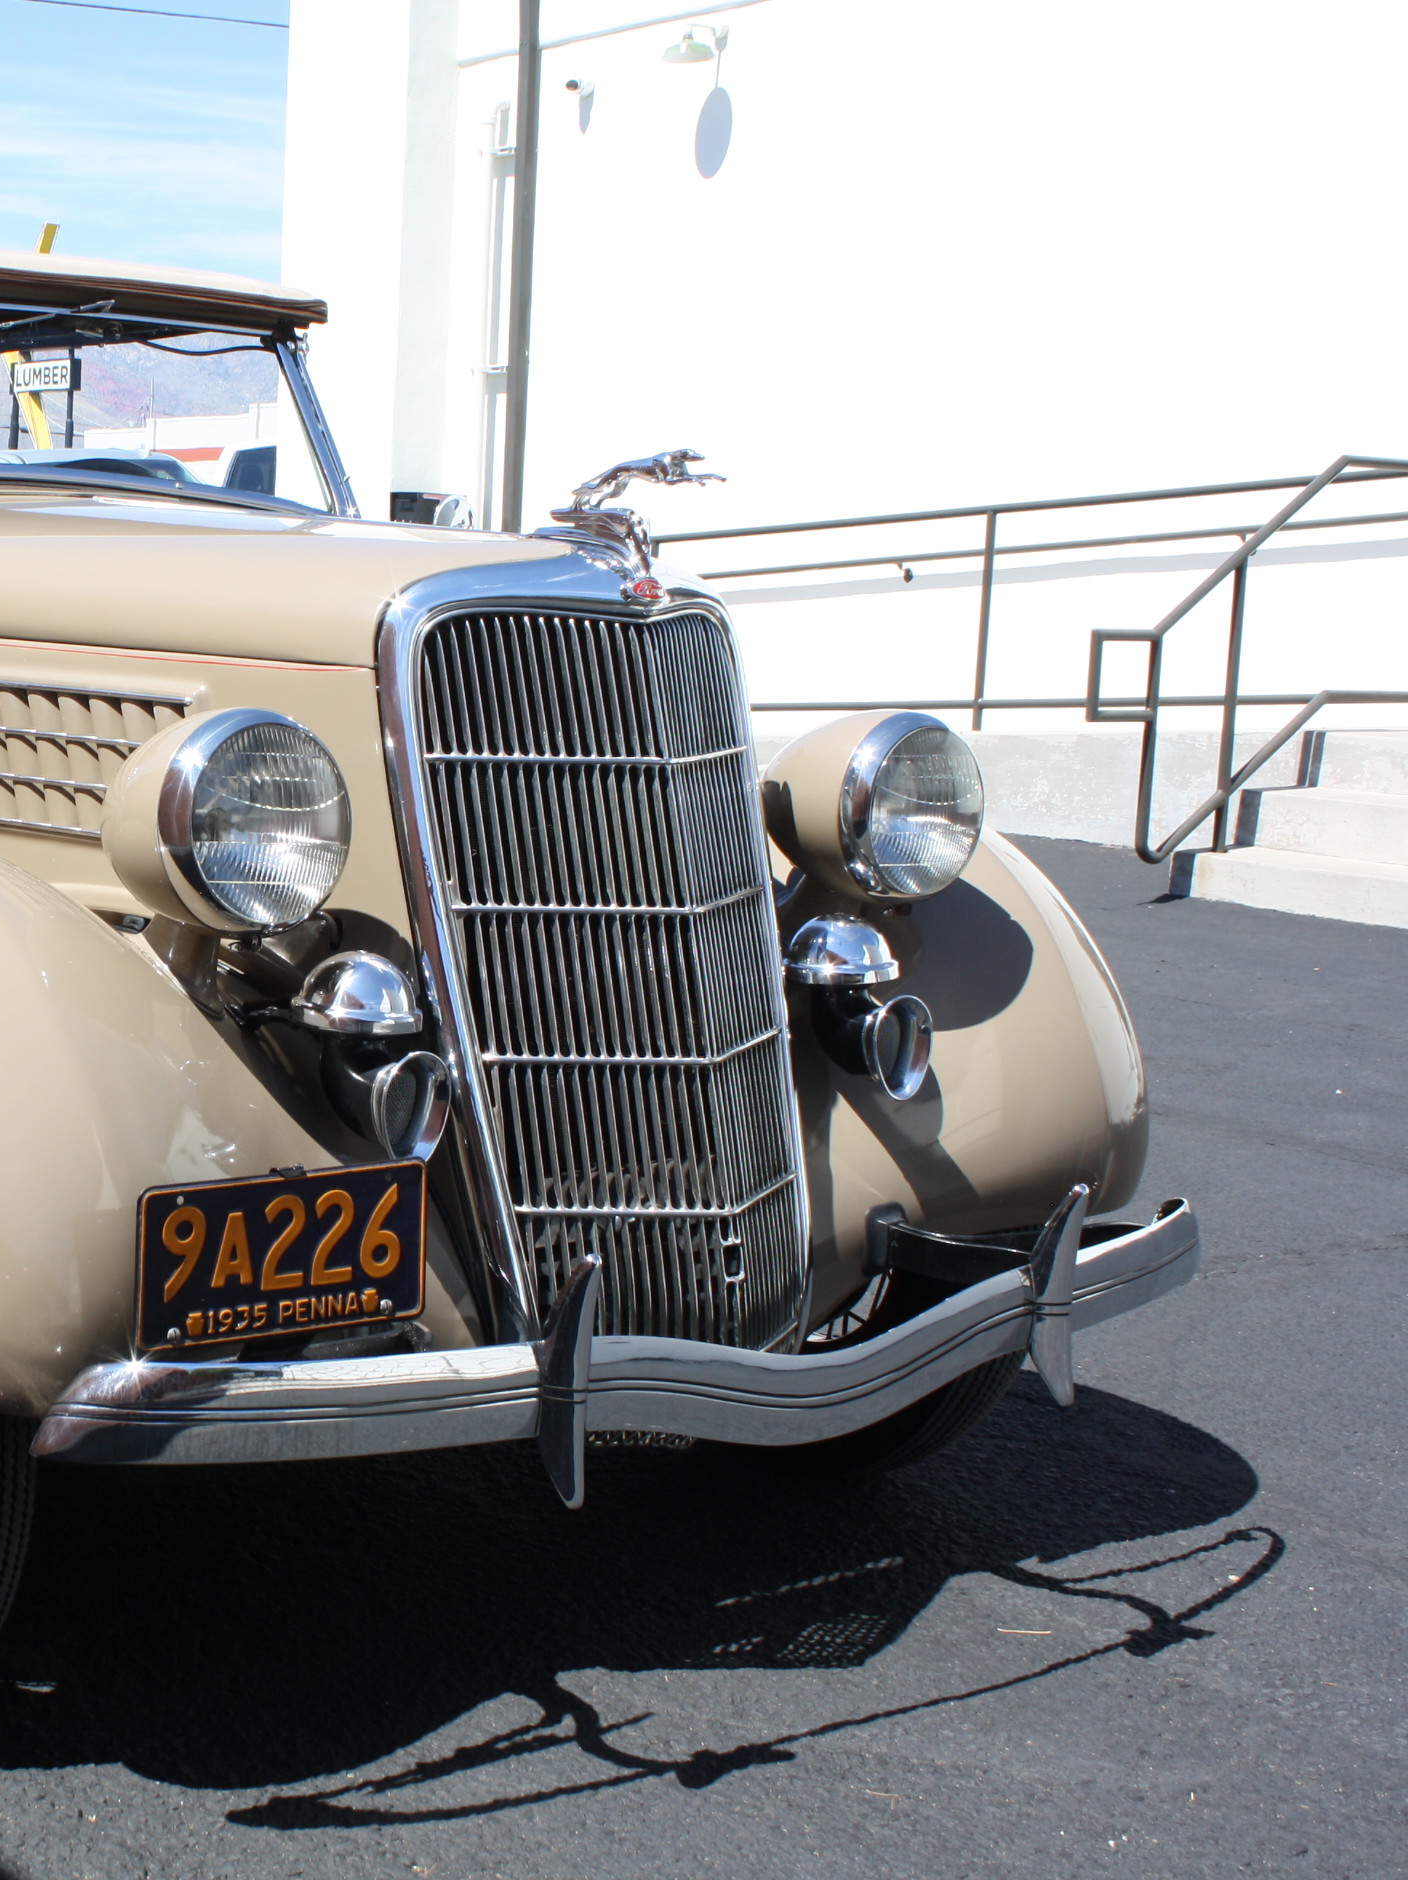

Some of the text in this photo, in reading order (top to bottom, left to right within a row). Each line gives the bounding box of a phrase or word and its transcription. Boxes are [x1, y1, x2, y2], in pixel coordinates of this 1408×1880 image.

[16, 365, 68, 388] LUMBER
[162, 1183, 401, 1303] 9A226
[207, 1291, 360, 1335] 1935 PENNA
